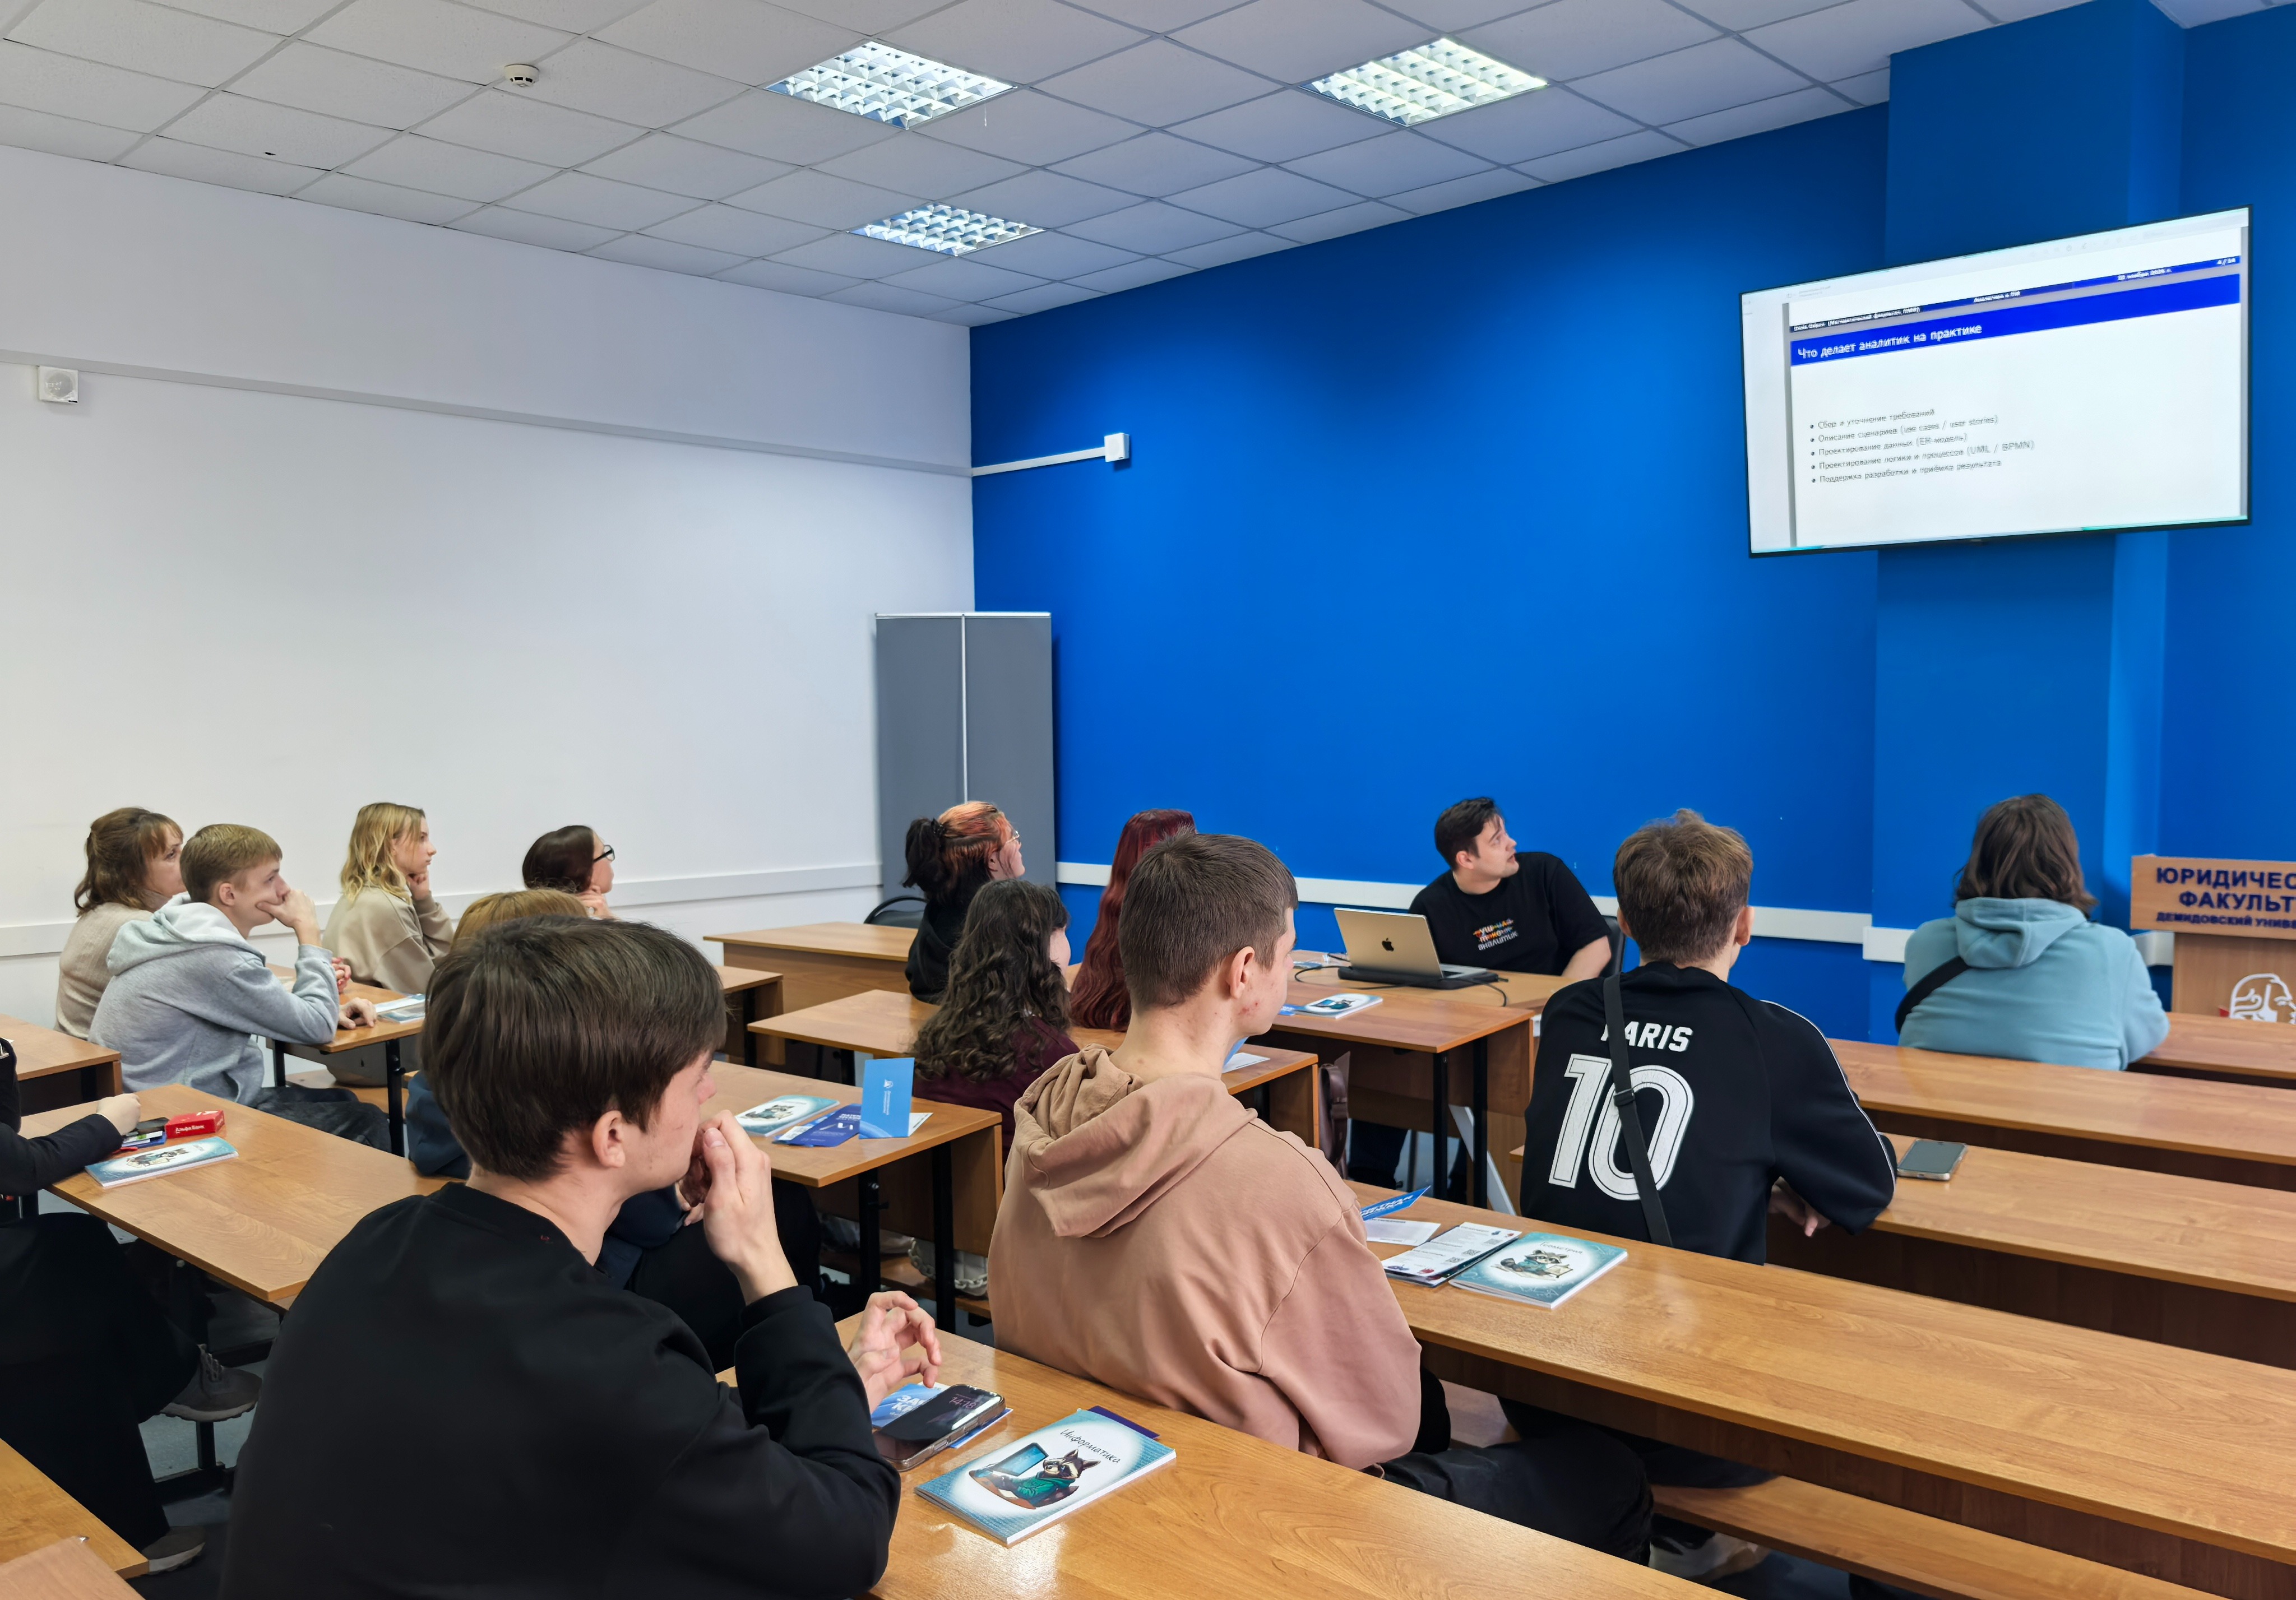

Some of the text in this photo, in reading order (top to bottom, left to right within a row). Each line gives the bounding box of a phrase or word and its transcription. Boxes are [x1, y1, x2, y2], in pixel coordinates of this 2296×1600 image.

[1798, 324, 1983, 359] Что делает аналитик на практике
[1818, 420, 1836, 429] Сбор
[1847, 416, 1887, 426] уточнение
[1890, 409, 1936, 421] требований
[1818, 433, 1855, 443] Описание
[1858, 429, 1897, 438] сценариев
[1900, 425, 1917, 435] (use
[1969, 414, 1999, 426] stories)
[1819, 433, 1968, 456] Проектирование данных (ER-модель)
[1820, 457, 1882, 470] Проектирование
[1884, 455, 1911, 463] логики
[1922, 450, 1964, 461] процессов
[1967, 446, 1992, 456] (UML
[2002, 440, 2035, 451] BPMN)
[1820, 474, 1862, 483] Поддержка
[1864, 469, 1909, 480] разработки
[1956, 460, 2002, 471] результата
[2156, 866, 2296, 889] ЮРИДИЧЕС
[2178, 890, 2296, 913] ФАКУЛЬТ
[2156, 912, 2253, 926] ДЕМИДОВСКИЙ
[1478, 931, 1518, 951] аналитик
[1601, 1021, 1693, 1052] ARIS
[1548, 1053, 1695, 1201] 10
[1540, 1241, 1583, 1254] Геометрия
[1060, 1429, 1121, 1464] Информатика
